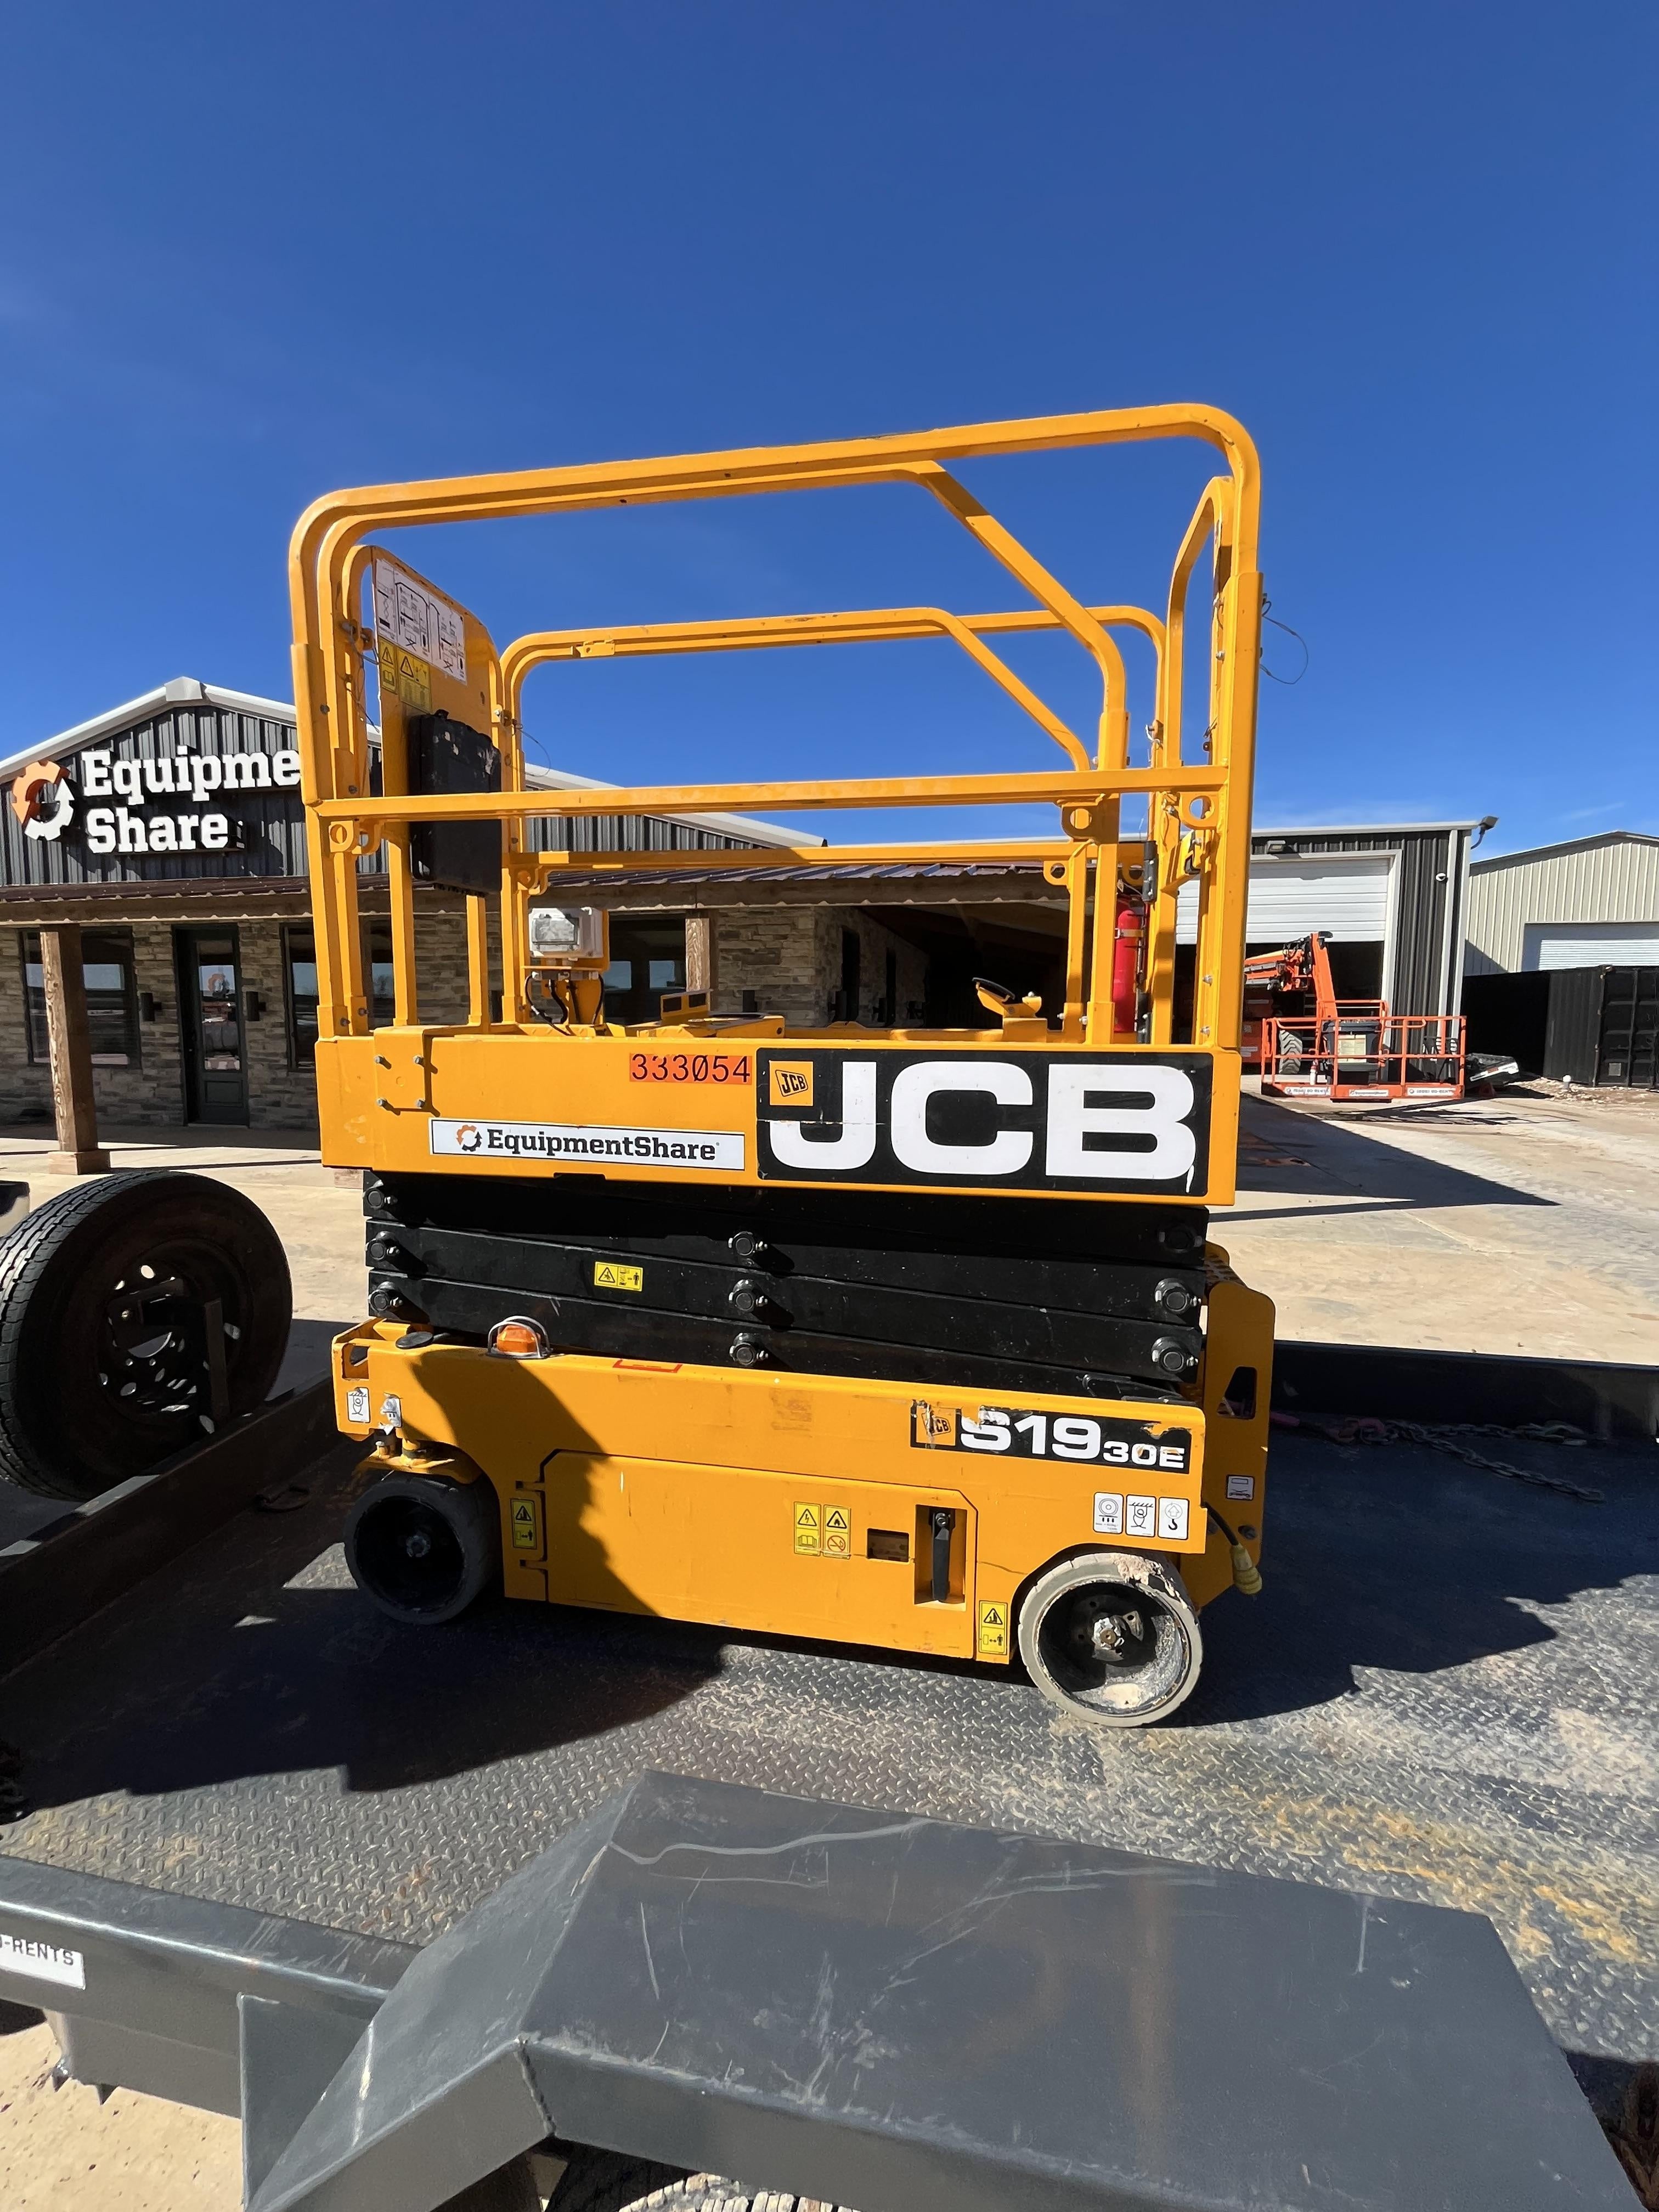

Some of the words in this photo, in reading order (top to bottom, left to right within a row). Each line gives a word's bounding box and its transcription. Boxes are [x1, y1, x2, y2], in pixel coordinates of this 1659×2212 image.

[81, 745, 301, 805] Equipme
[86, 806, 228, 853] Share
[631, 1053, 751, 1082] 333054
[781, 1073, 806, 1093] JCB
[769, 1061, 1196, 1180] JCB
[487, 1128, 715, 1160] EquipmentShare
[0, 1934, 74, 1966] -RENTS
